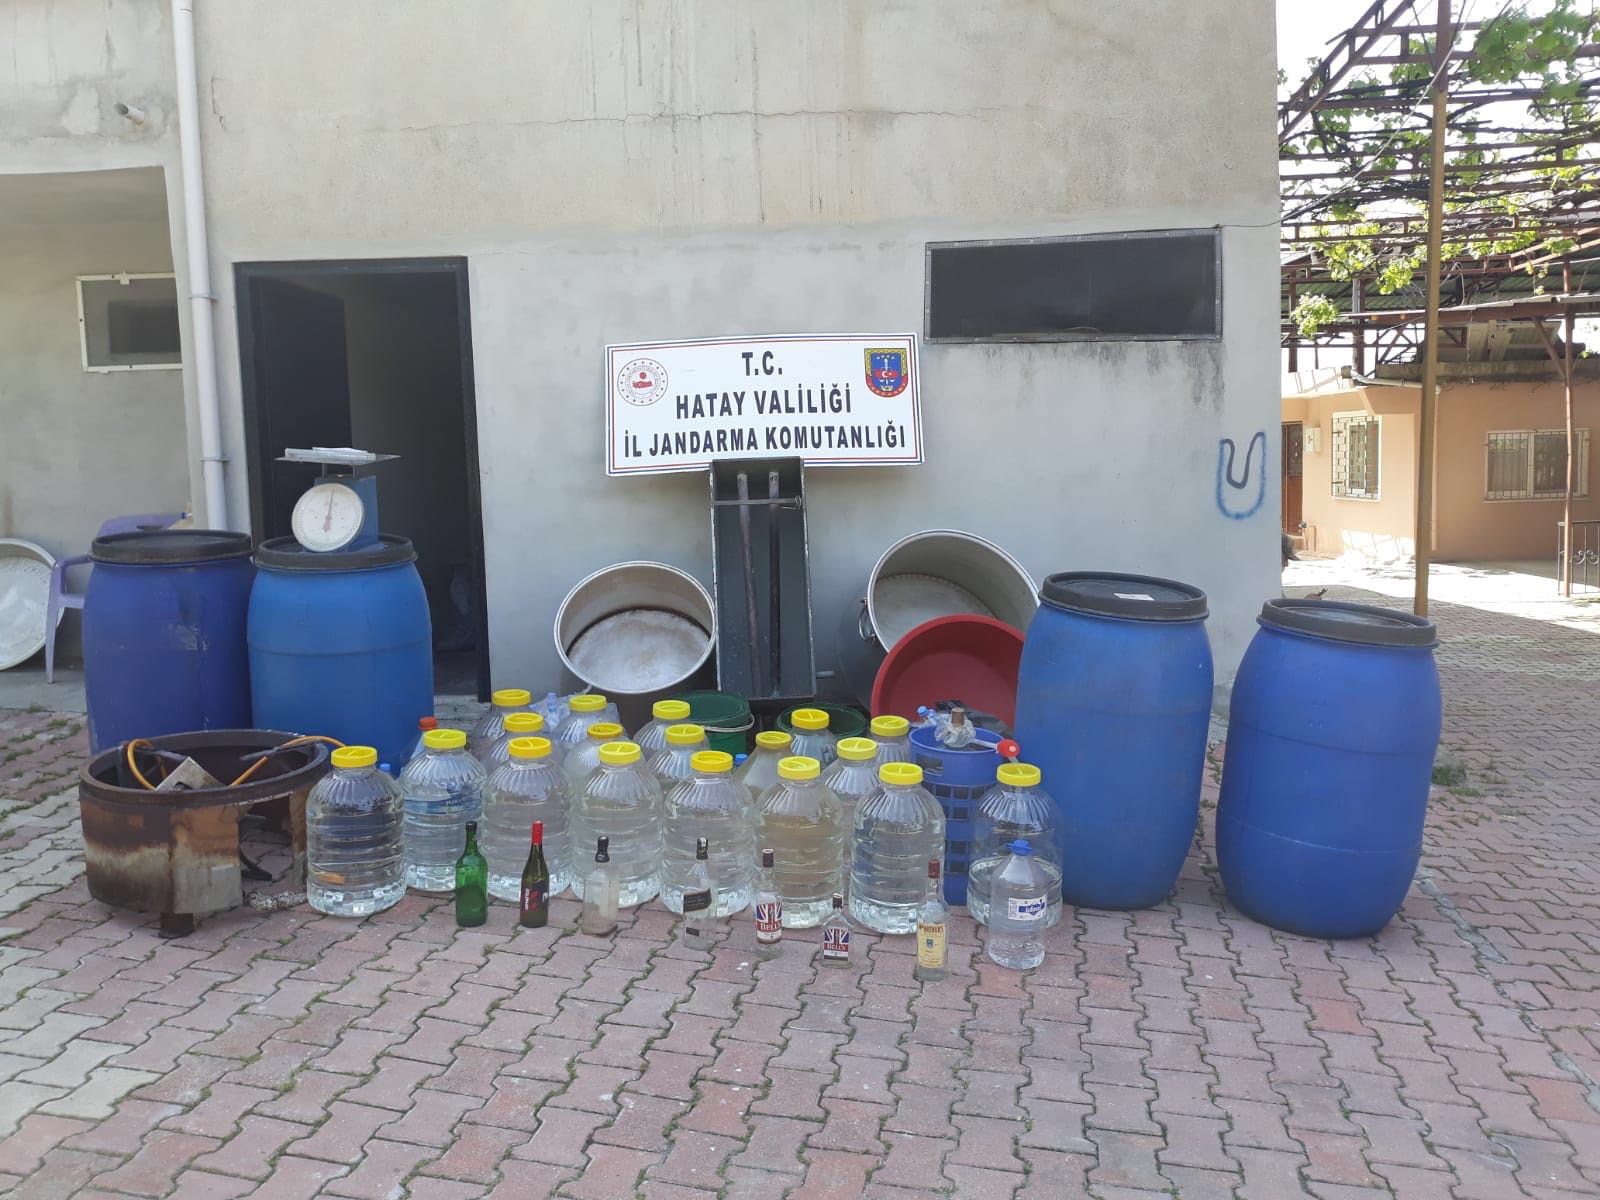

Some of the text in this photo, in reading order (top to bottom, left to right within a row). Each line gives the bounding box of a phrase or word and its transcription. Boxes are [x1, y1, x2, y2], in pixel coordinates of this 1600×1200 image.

[741, 350, 783, 376] T.C.
[676, 383, 851, 420] HATAY VALİLİĞİ
[624, 420, 905, 457] İL JANDARMA KOMUTANLIĞI
